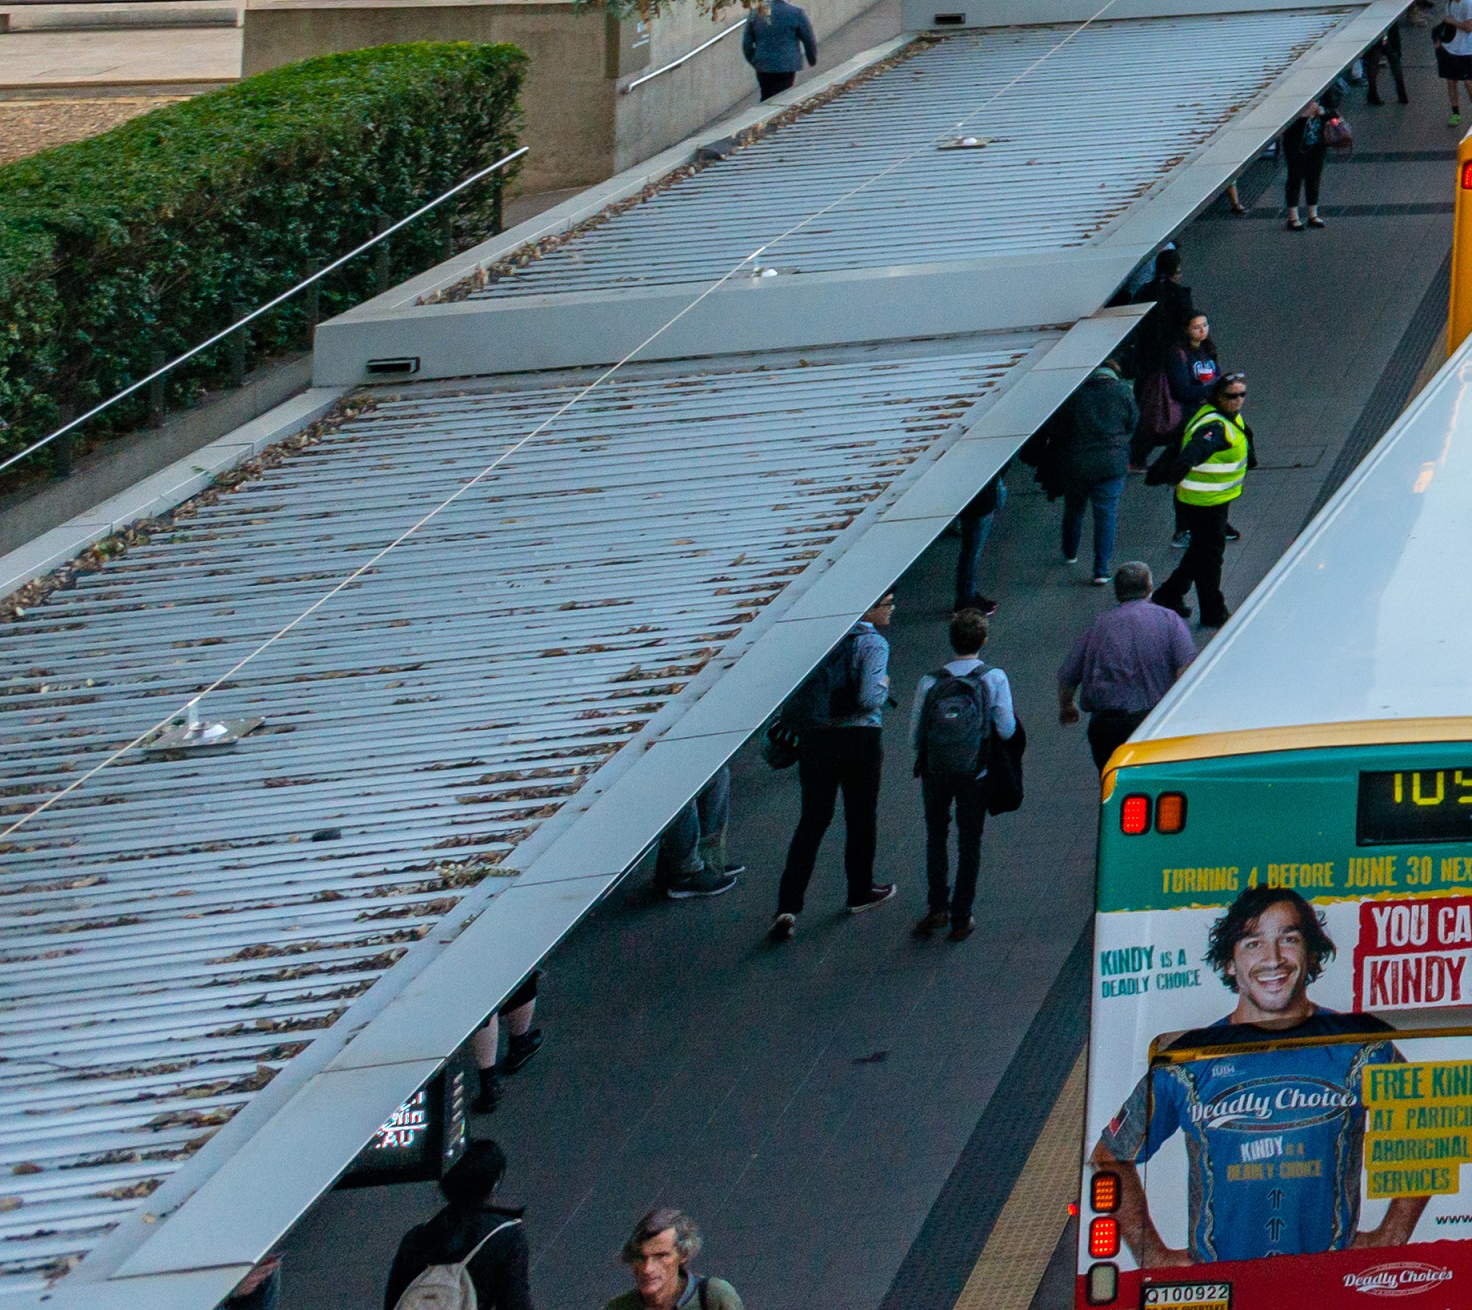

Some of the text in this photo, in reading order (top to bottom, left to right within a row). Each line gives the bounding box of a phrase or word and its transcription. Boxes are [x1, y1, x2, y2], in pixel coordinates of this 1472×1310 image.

[1162, 867, 1239, 893] TURNING
[1247, 868, 1258, 890] 4
[1266, 862, 1335, 889] BEFORE
[1344, 856, 1398, 888] JUNE
[1407, 856, 1433, 885] 30
[1372, 903, 1429, 948] YOU
[1101, 945, 1187, 976] KINDY IS A
[1102, 969, 1202, 998] DEADLY CHOICE
[1369, 955, 1468, 1006] KINDY
[1370, 1067, 1424, 1102] FREE
[1187, 1092, 1273, 1123] Deadly
[1373, 1109, 1393, 1131] AT
[1240, 1135, 1284, 1163] KINDY
[1371, 1135, 1470, 1163] ABORIGINAL
[1279, 1159, 1322, 1179] CHOICE
[1373, 1168, 1450, 1193] SERVICES
[1342, 1267, 1453, 1290] Deadly Choices
[1146, 1285, 1229, 1303] Q100922
